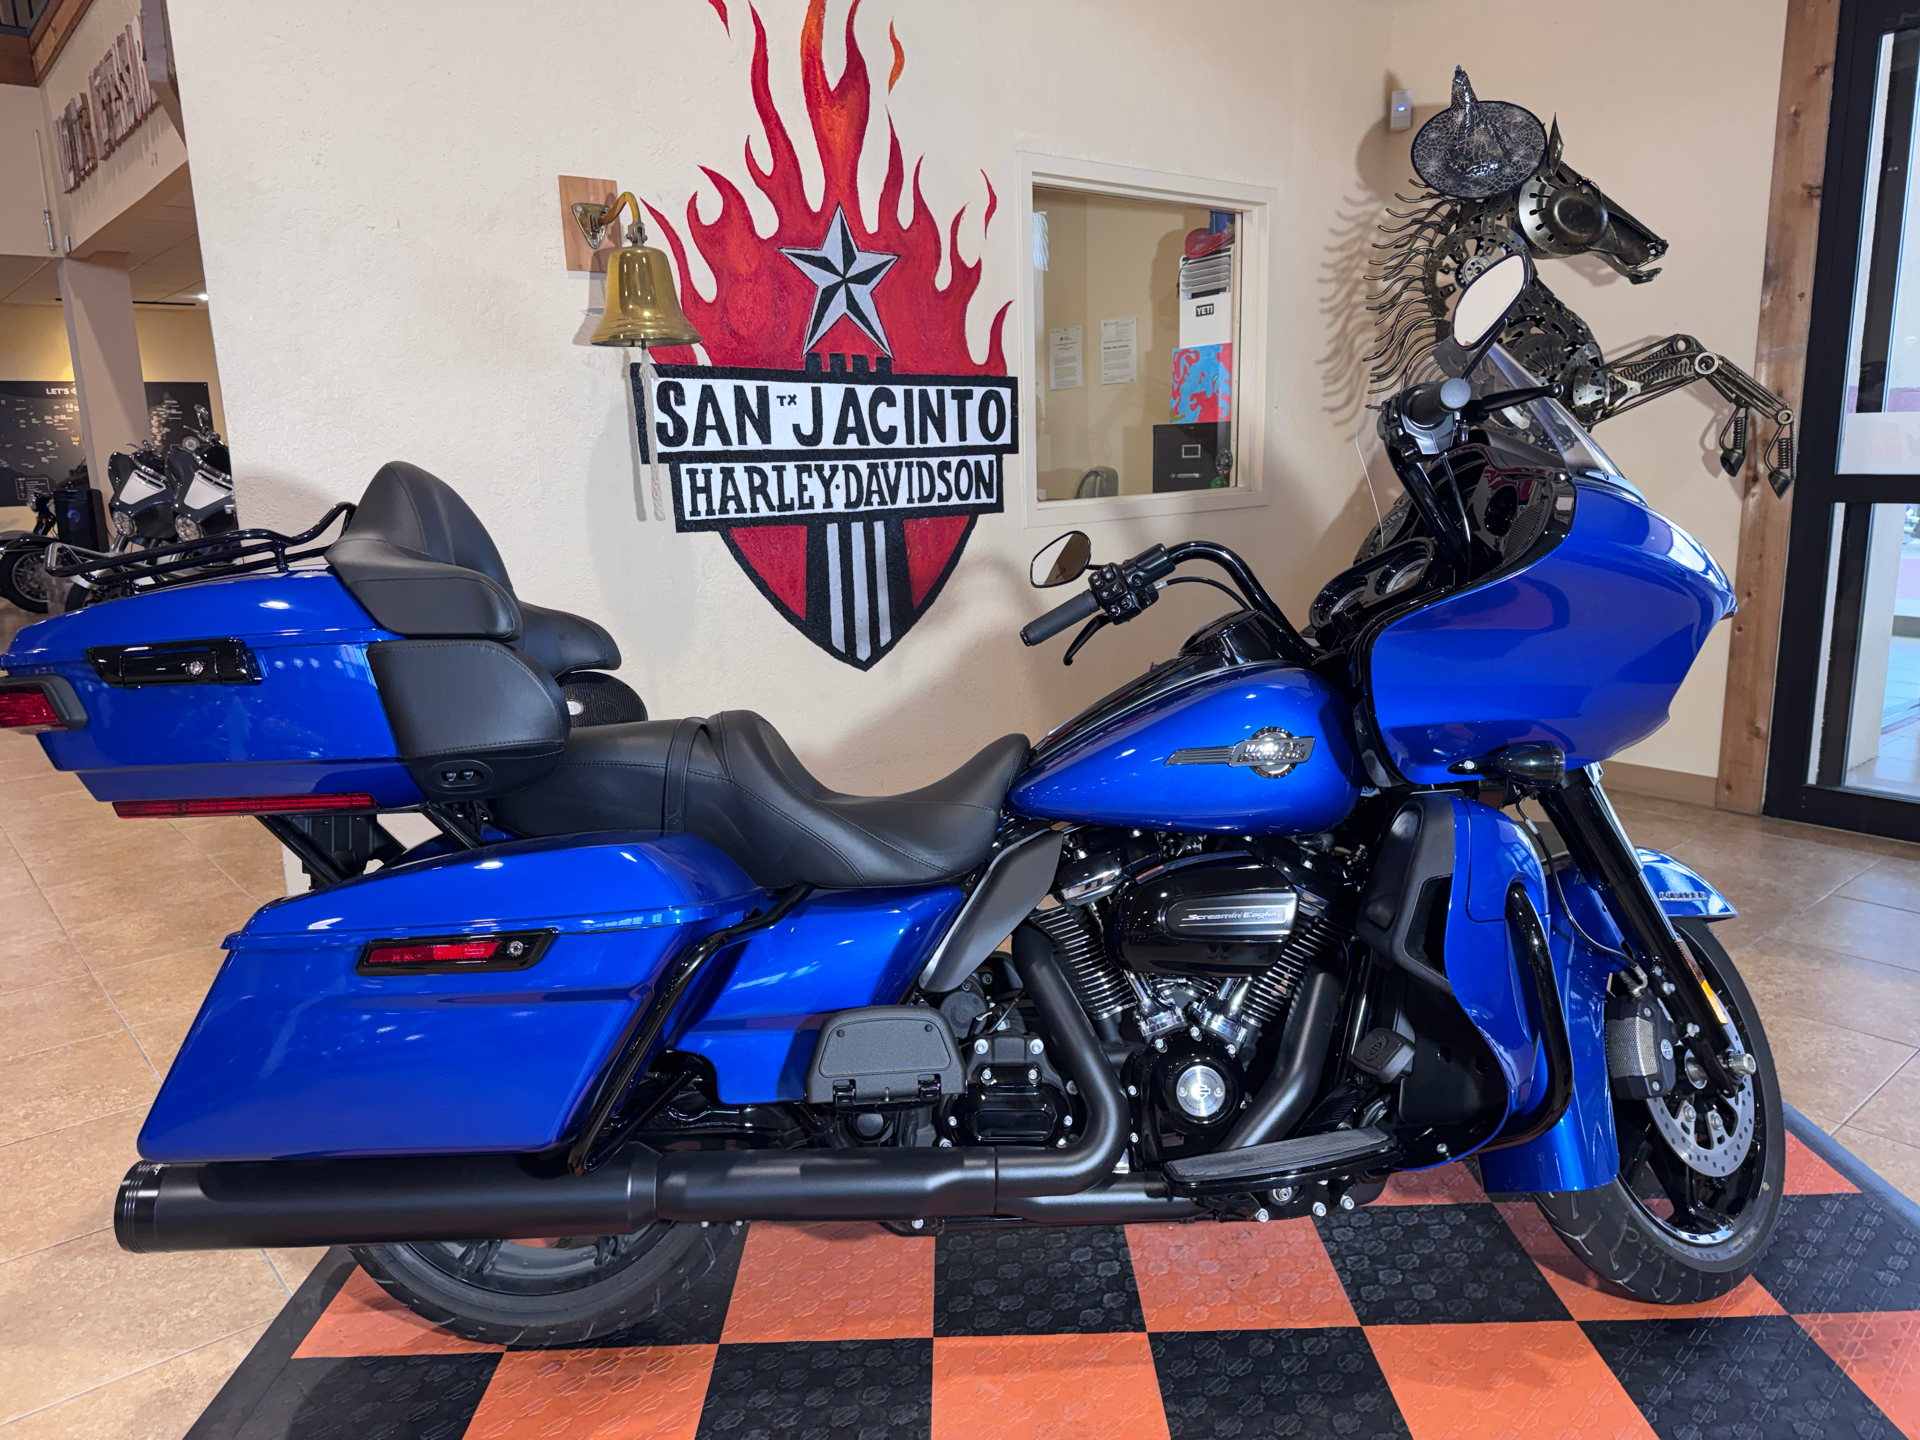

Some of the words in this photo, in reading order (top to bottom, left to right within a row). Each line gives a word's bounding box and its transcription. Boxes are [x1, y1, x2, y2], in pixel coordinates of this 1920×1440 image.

[1196, 305, 1213, 316] YETI
[45, 387, 70, 395] LET'S
[656, 380, 772, 447] SAN
[776, 393, 798, 406] TX
[792, 386, 1006, 447] JACINTO
[1243, 911, 1277, 919] Eagle
